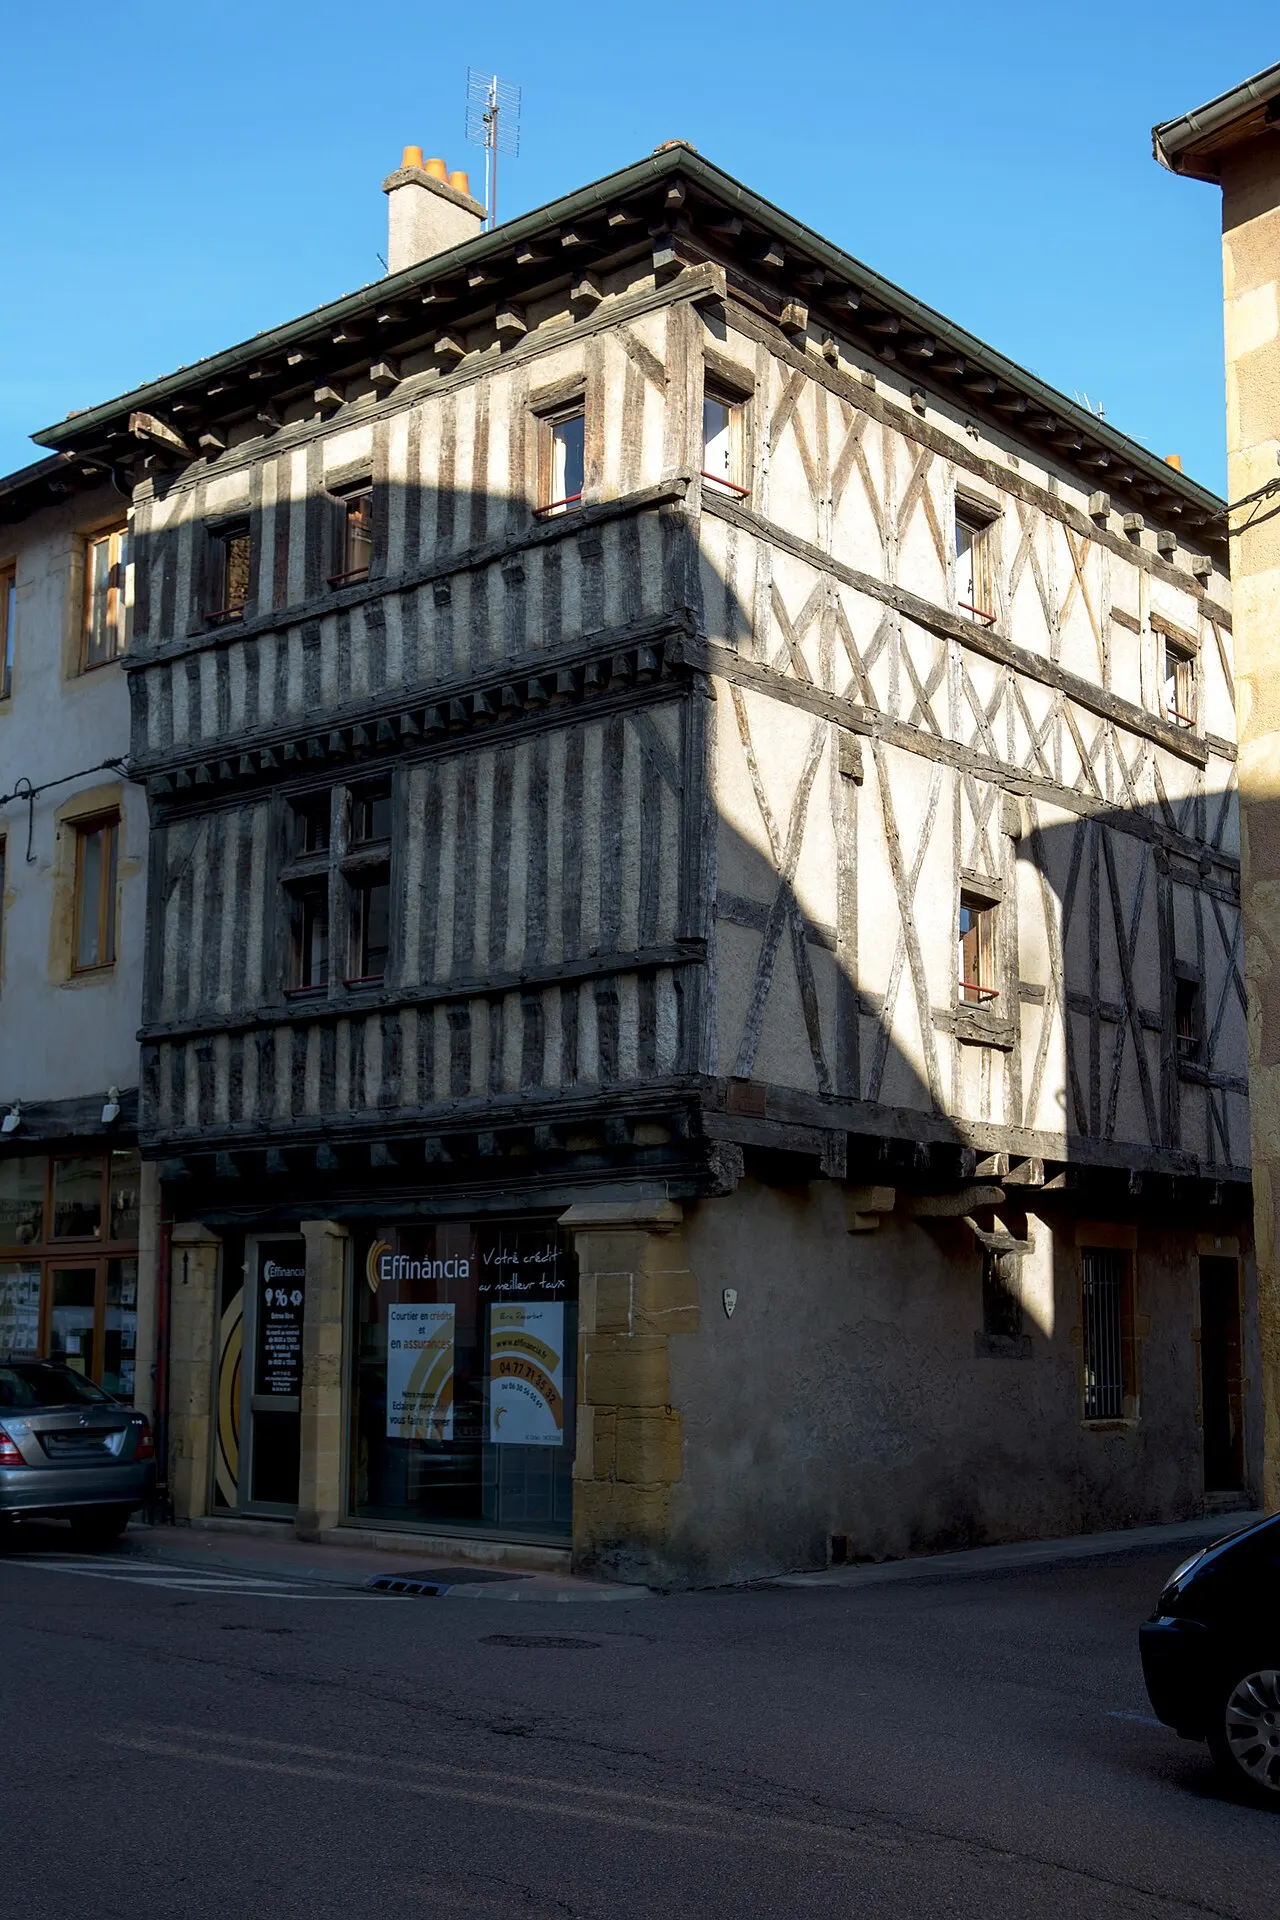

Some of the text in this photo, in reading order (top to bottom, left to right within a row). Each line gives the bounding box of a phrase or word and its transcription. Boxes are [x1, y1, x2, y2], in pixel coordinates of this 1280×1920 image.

[483, 1247, 520, 1265] Votre
[269, 1264, 305, 1278] Effinancia
[380, 1254, 470, 1280] Effinancia
[494, 1271, 536, 1291] meilleur
[538, 1271, 566, 1289] taux
[390, 1310, 419, 1321] Courtier
[420, 1312, 429, 1321] en
[417, 1326, 426, 1335] et
[390, 1339, 453, 1350] en assurances
[499, 1361, 557, 1405] 04 77 71 35 32
